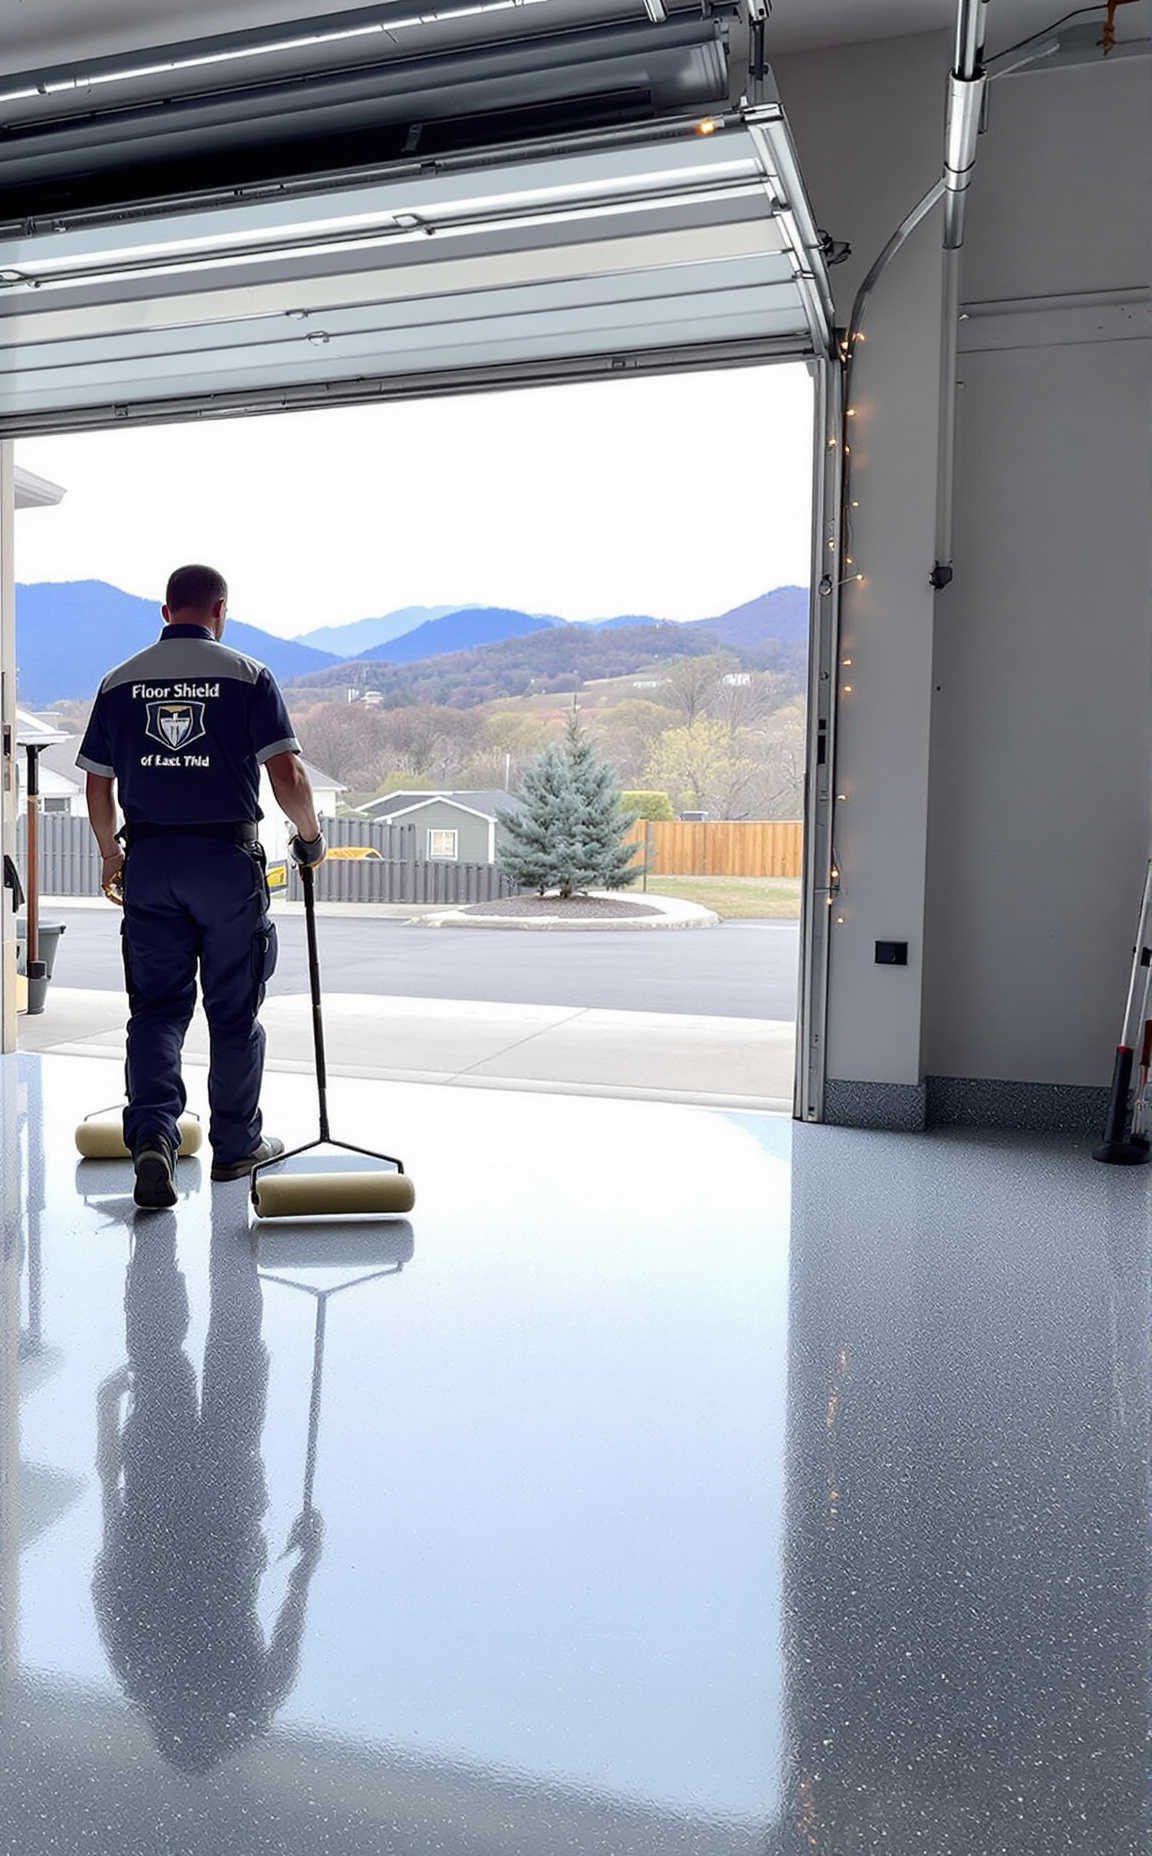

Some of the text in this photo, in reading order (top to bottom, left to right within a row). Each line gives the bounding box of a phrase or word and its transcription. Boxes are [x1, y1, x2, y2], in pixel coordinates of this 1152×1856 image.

[132, 683, 220, 698] Floor Shield
[140, 754, 153, 767] of
